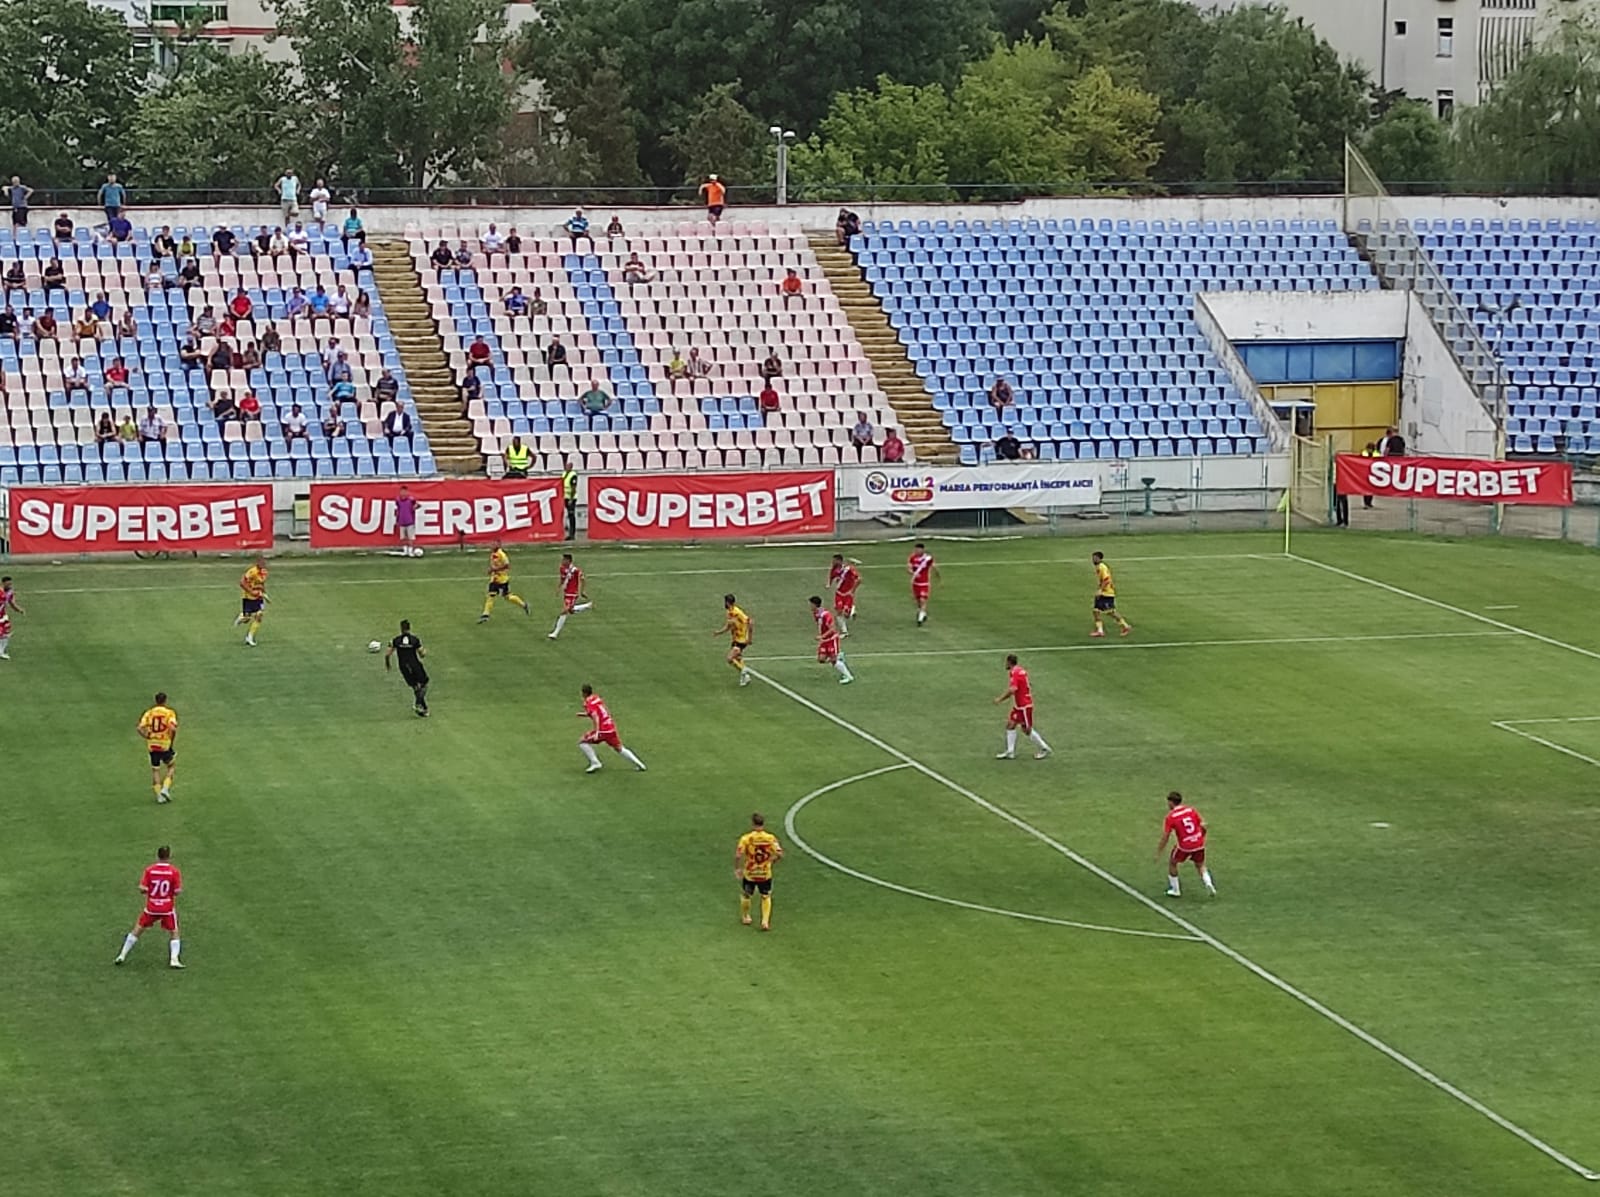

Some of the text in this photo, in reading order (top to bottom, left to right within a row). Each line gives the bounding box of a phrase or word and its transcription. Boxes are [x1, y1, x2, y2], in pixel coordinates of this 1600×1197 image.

[890, 476, 935, 488] LIGA 2
[1368, 460, 1541, 496] SUPERBET
[17, 494, 266, 542] SUPERBET
[595, 480, 827, 529] SUPERBET
[1182, 816, 1195, 834] 5
[150, 880, 170, 896] 70
